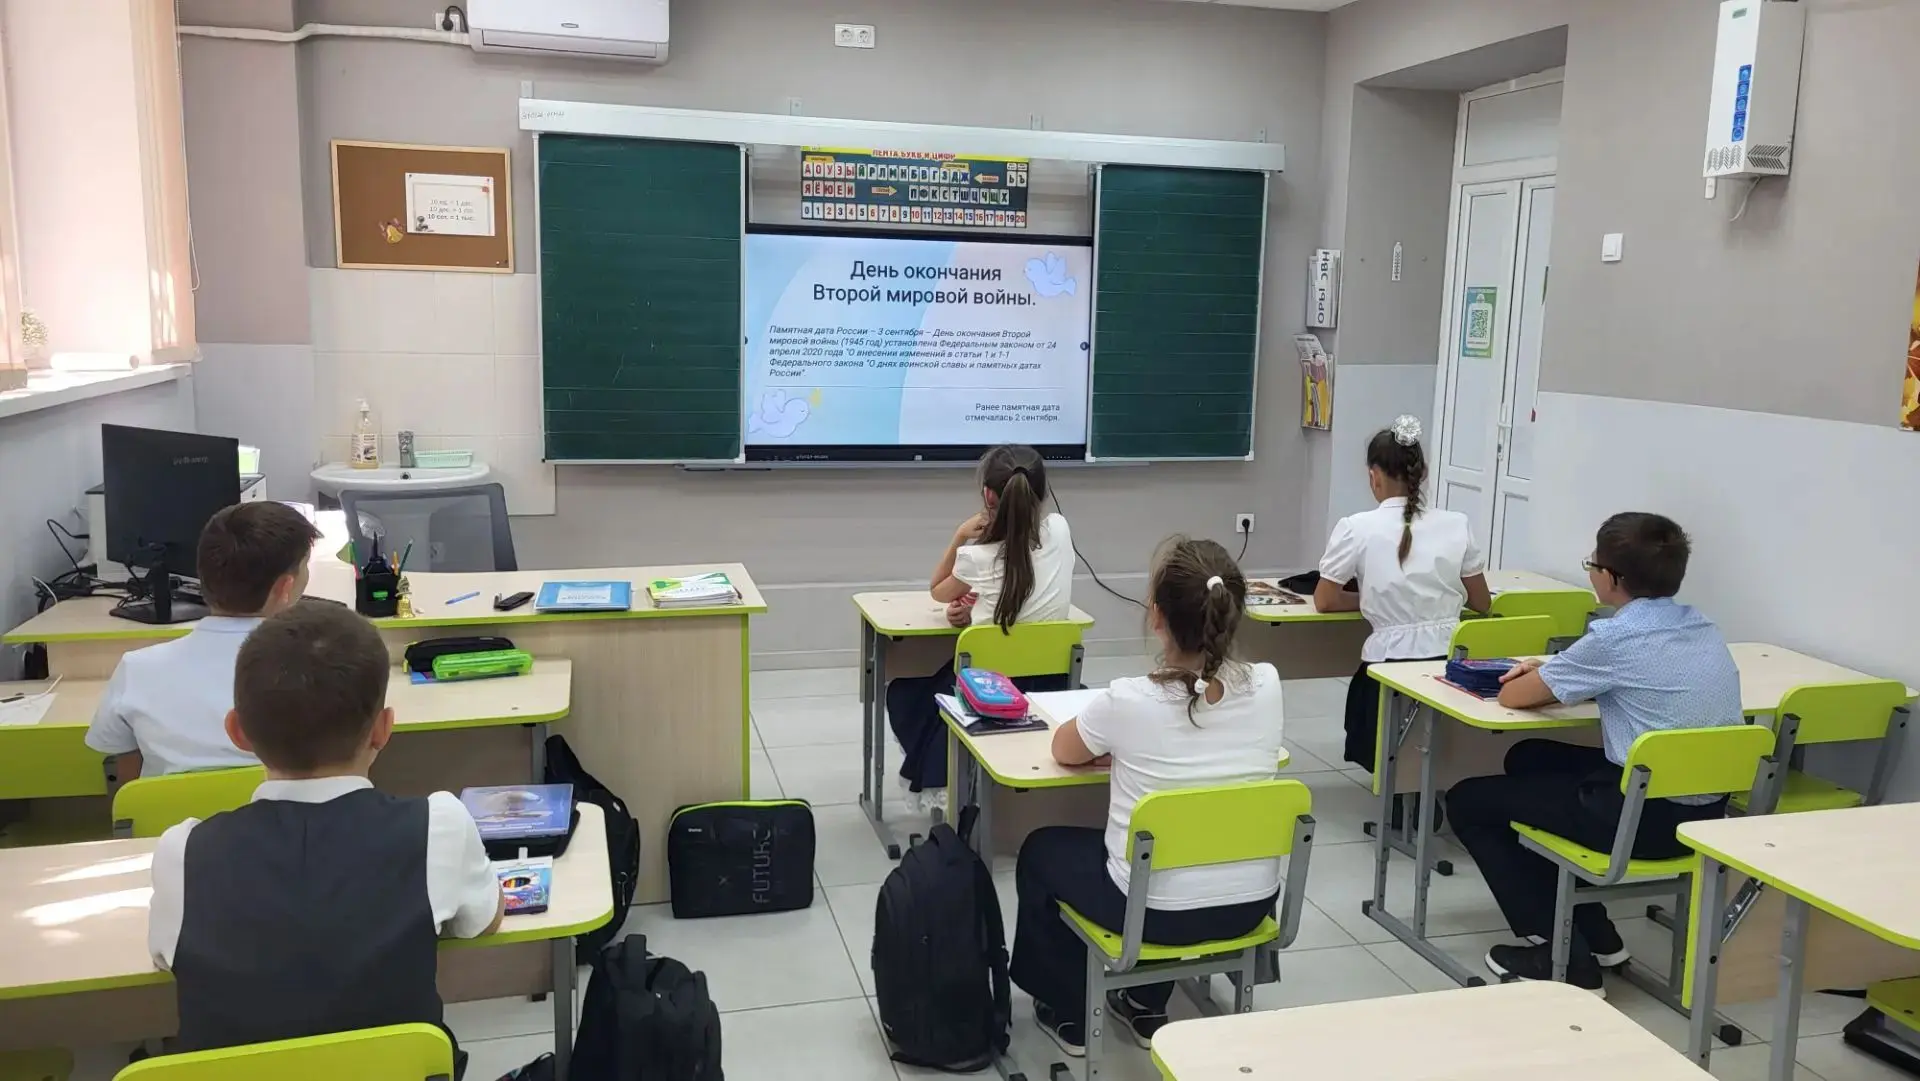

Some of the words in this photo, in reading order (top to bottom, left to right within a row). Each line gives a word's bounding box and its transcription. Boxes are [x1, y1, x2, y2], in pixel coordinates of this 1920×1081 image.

[827, 207, 832, 215] 2
[871, 209, 875, 217] 6
[903, 210, 907, 218] 9
[911, 211, 919, 219] 10
[923, 211, 930, 219] 11
[934, 211, 941, 219] 12
[944, 212, 952, 220] 13
[965, 213, 972, 221] 15
[975, 213, 983, 221] 16
[996, 214, 1003, 222] 18
[1016, 215, 1025, 223] 20
[850, 260, 899, 281] День
[904, 265, 1001, 281] окончания
[813, 283, 880, 305] Второй
[887, 287, 967, 307] мировой
[974, 289, 1036, 306] войны.
[769, 325, 812, 334] Памятная
[814, 327, 834, 336] дата
[836, 327, 868, 335] России
[877, 328, 882, 336] 3
[885, 328, 924, 338] сентября
[933, 329, 954, 338] День
[1002, 330, 1031, 339] Второй
[769, 337, 808, 346] мировой
[810, 337, 839, 345] войны
[841, 338, 864, 347] (1945
[865, 339, 882, 347] год)
[884, 340, 937, 348] установлена
[939, 340, 998, 349] Федеральным
[1046, 341, 1056, 349] 24
[769, 349, 800, 357] апреля
[802, 348, 822, 356] 2020
[824, 349, 843, 357] года
[899, 349, 946, 358] изменений
[769, 358, 832, 368] Федерального
[833, 360, 864, 368] закона
[876, 361, 897, 369] днях
[899, 360, 939, 369] воинской
[975, 403, 1000, 411] Ранее
[1042, 404, 1060, 412] дата
[1015, 413, 1020, 421] 2
